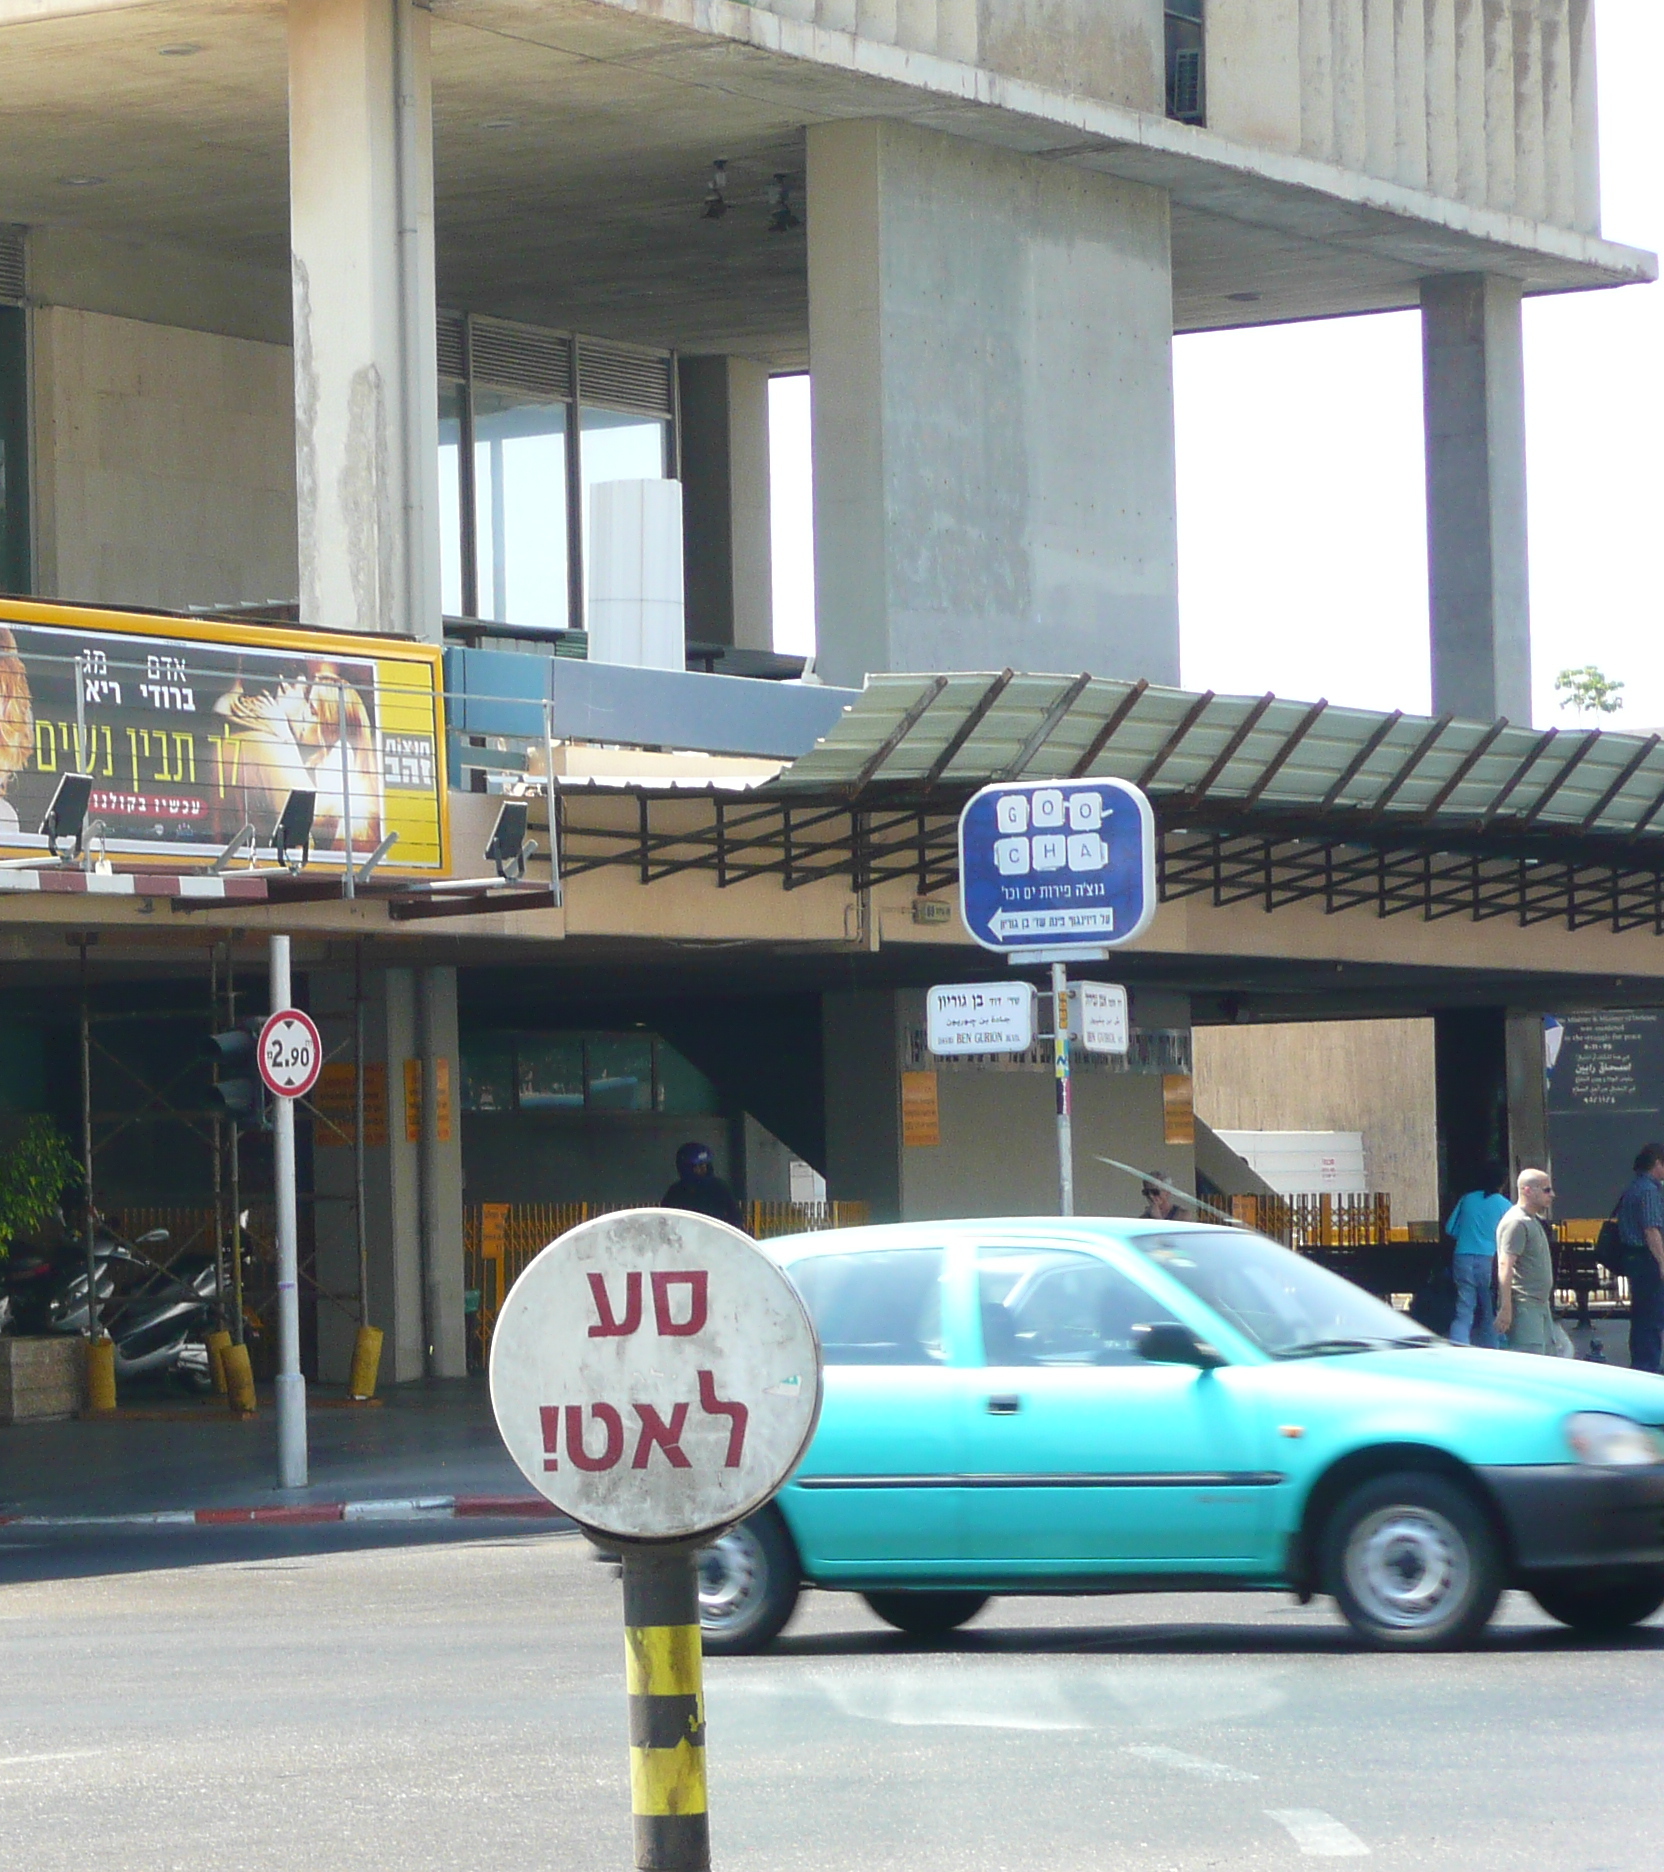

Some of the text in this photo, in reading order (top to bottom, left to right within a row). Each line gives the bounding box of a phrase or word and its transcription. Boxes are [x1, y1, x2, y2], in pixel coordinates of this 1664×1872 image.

[82, 648, 107, 675] מג
[147, 654, 187, 682] אדם
[83, 679, 122, 704] ריא
[139, 684, 197, 712] ברודי
[385, 737, 431, 754] חוצות
[35, 719, 242, 800] לך תבין נשים
[384, 755, 432, 786] זהב
[93, 792, 201, 815] עכשיו בקולנו
[1008, 841, 1094, 864] CHA
[1023, 885, 1036, 900] ים
[1039, 884, 1072, 900] פירות
[937, 993, 967, 1012] גוריון
[972, 993, 984, 1011] בן
[956, 1032, 972, 1045] BEN
[974, 1031, 1003, 1044] GURION
[271, 1039, 310, 1067] 2.90
[586, 1269, 709, 1338] סע
[539, 1369, 749, 1473] לאט!
